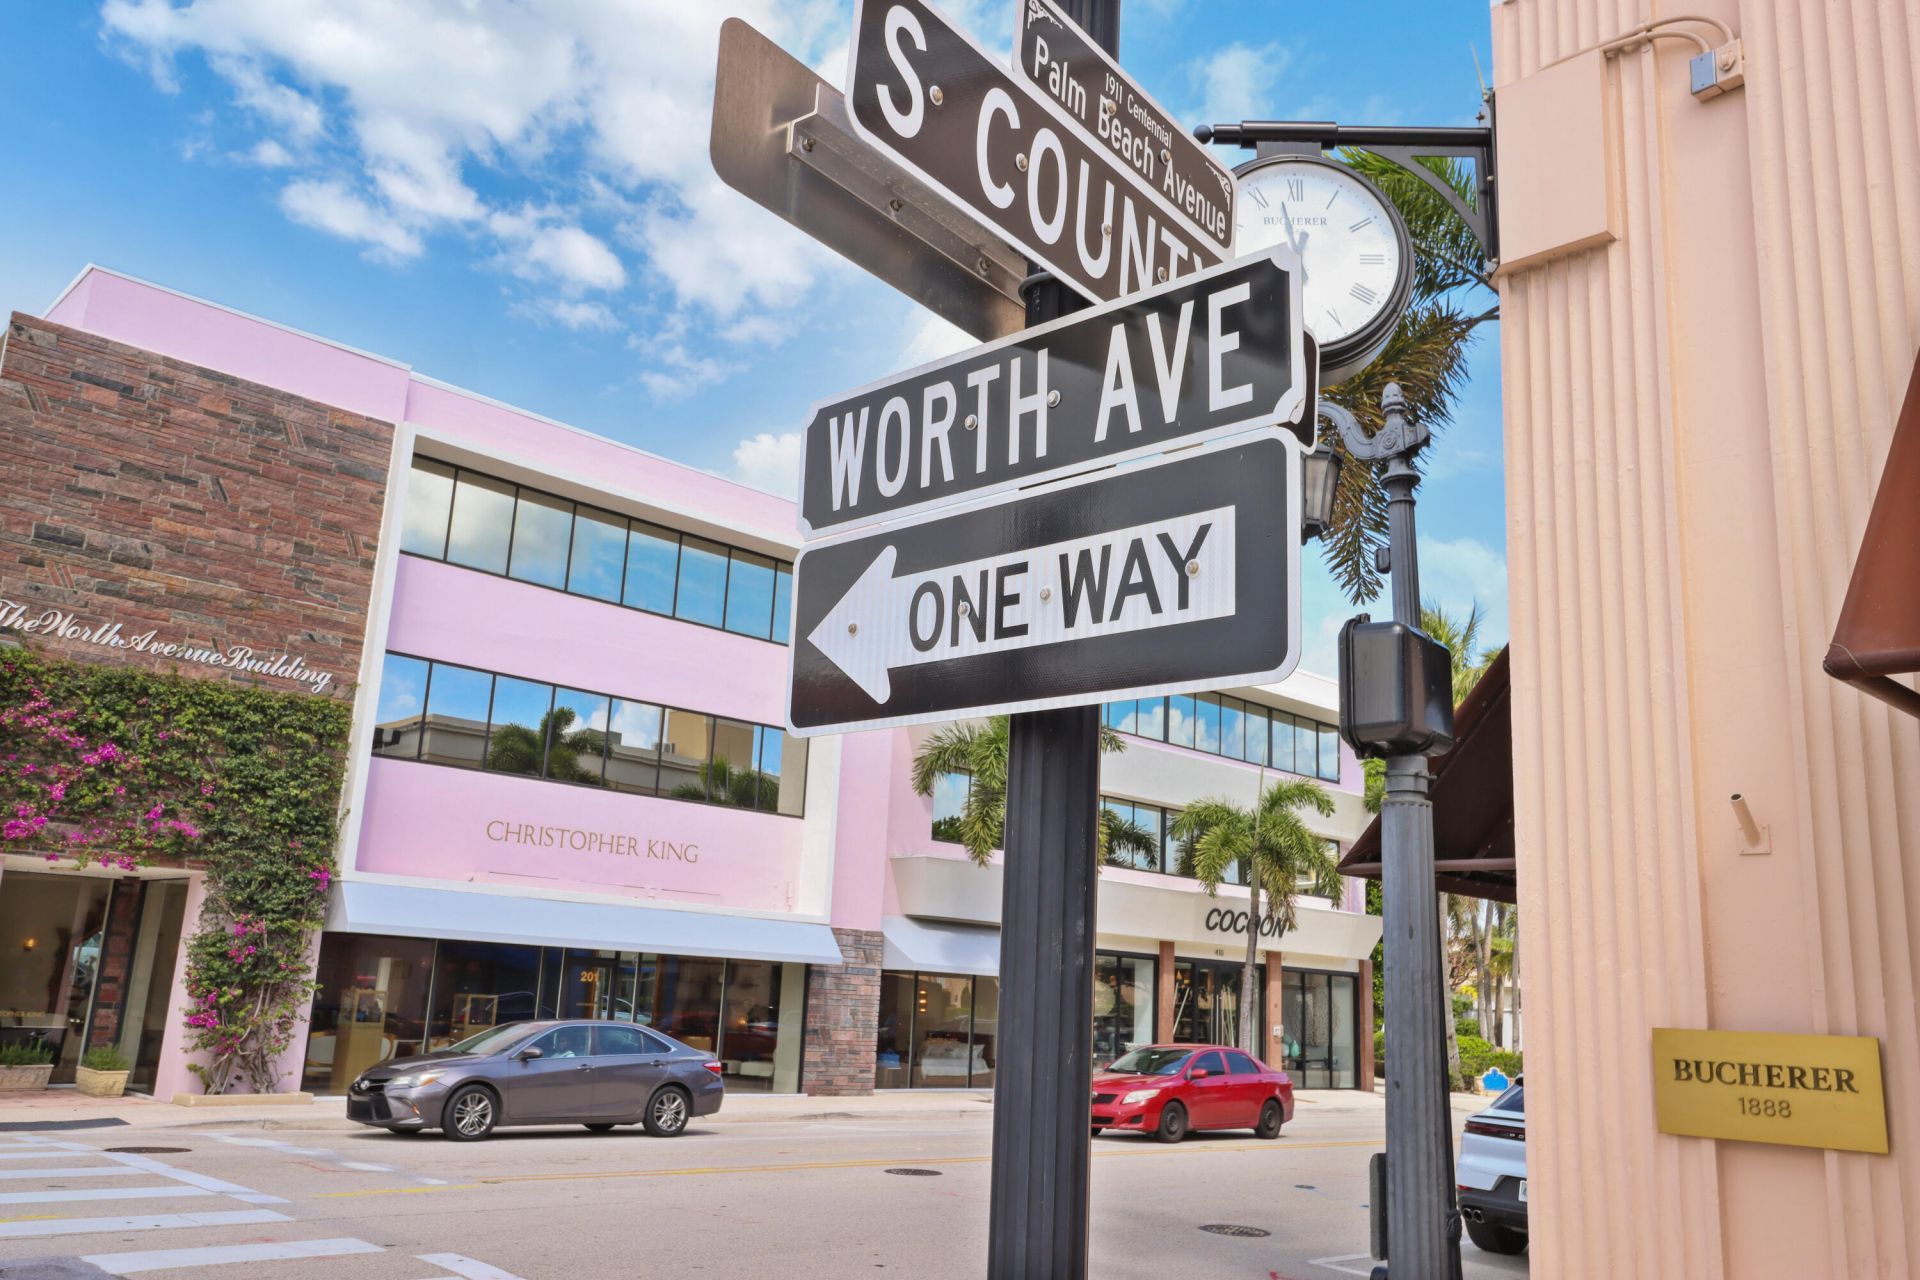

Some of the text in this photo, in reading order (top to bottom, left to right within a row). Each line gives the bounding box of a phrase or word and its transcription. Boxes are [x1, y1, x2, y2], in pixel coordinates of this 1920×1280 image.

[1034, 35, 1226, 240] Palm Beach Avenue
[1105, 73, 1172, 148] 1911 Centennial
[976, 87, 1205, 297] COUNT
[829, 282, 1253, 511] WORTH AVE
[908, 521, 1213, 652] ONE WAY
[39, 609, 123, 648] Worth
[119, 630, 226, 666] Avenue
[219, 646, 333, 694] Building
[486, 821, 699, 864] CHRISTOPHER KING
[1205, 907, 1287, 938] COCOON
[1672, 1058, 1860, 1093] BUCHERER
[1738, 1096, 1792, 1119] 1888
